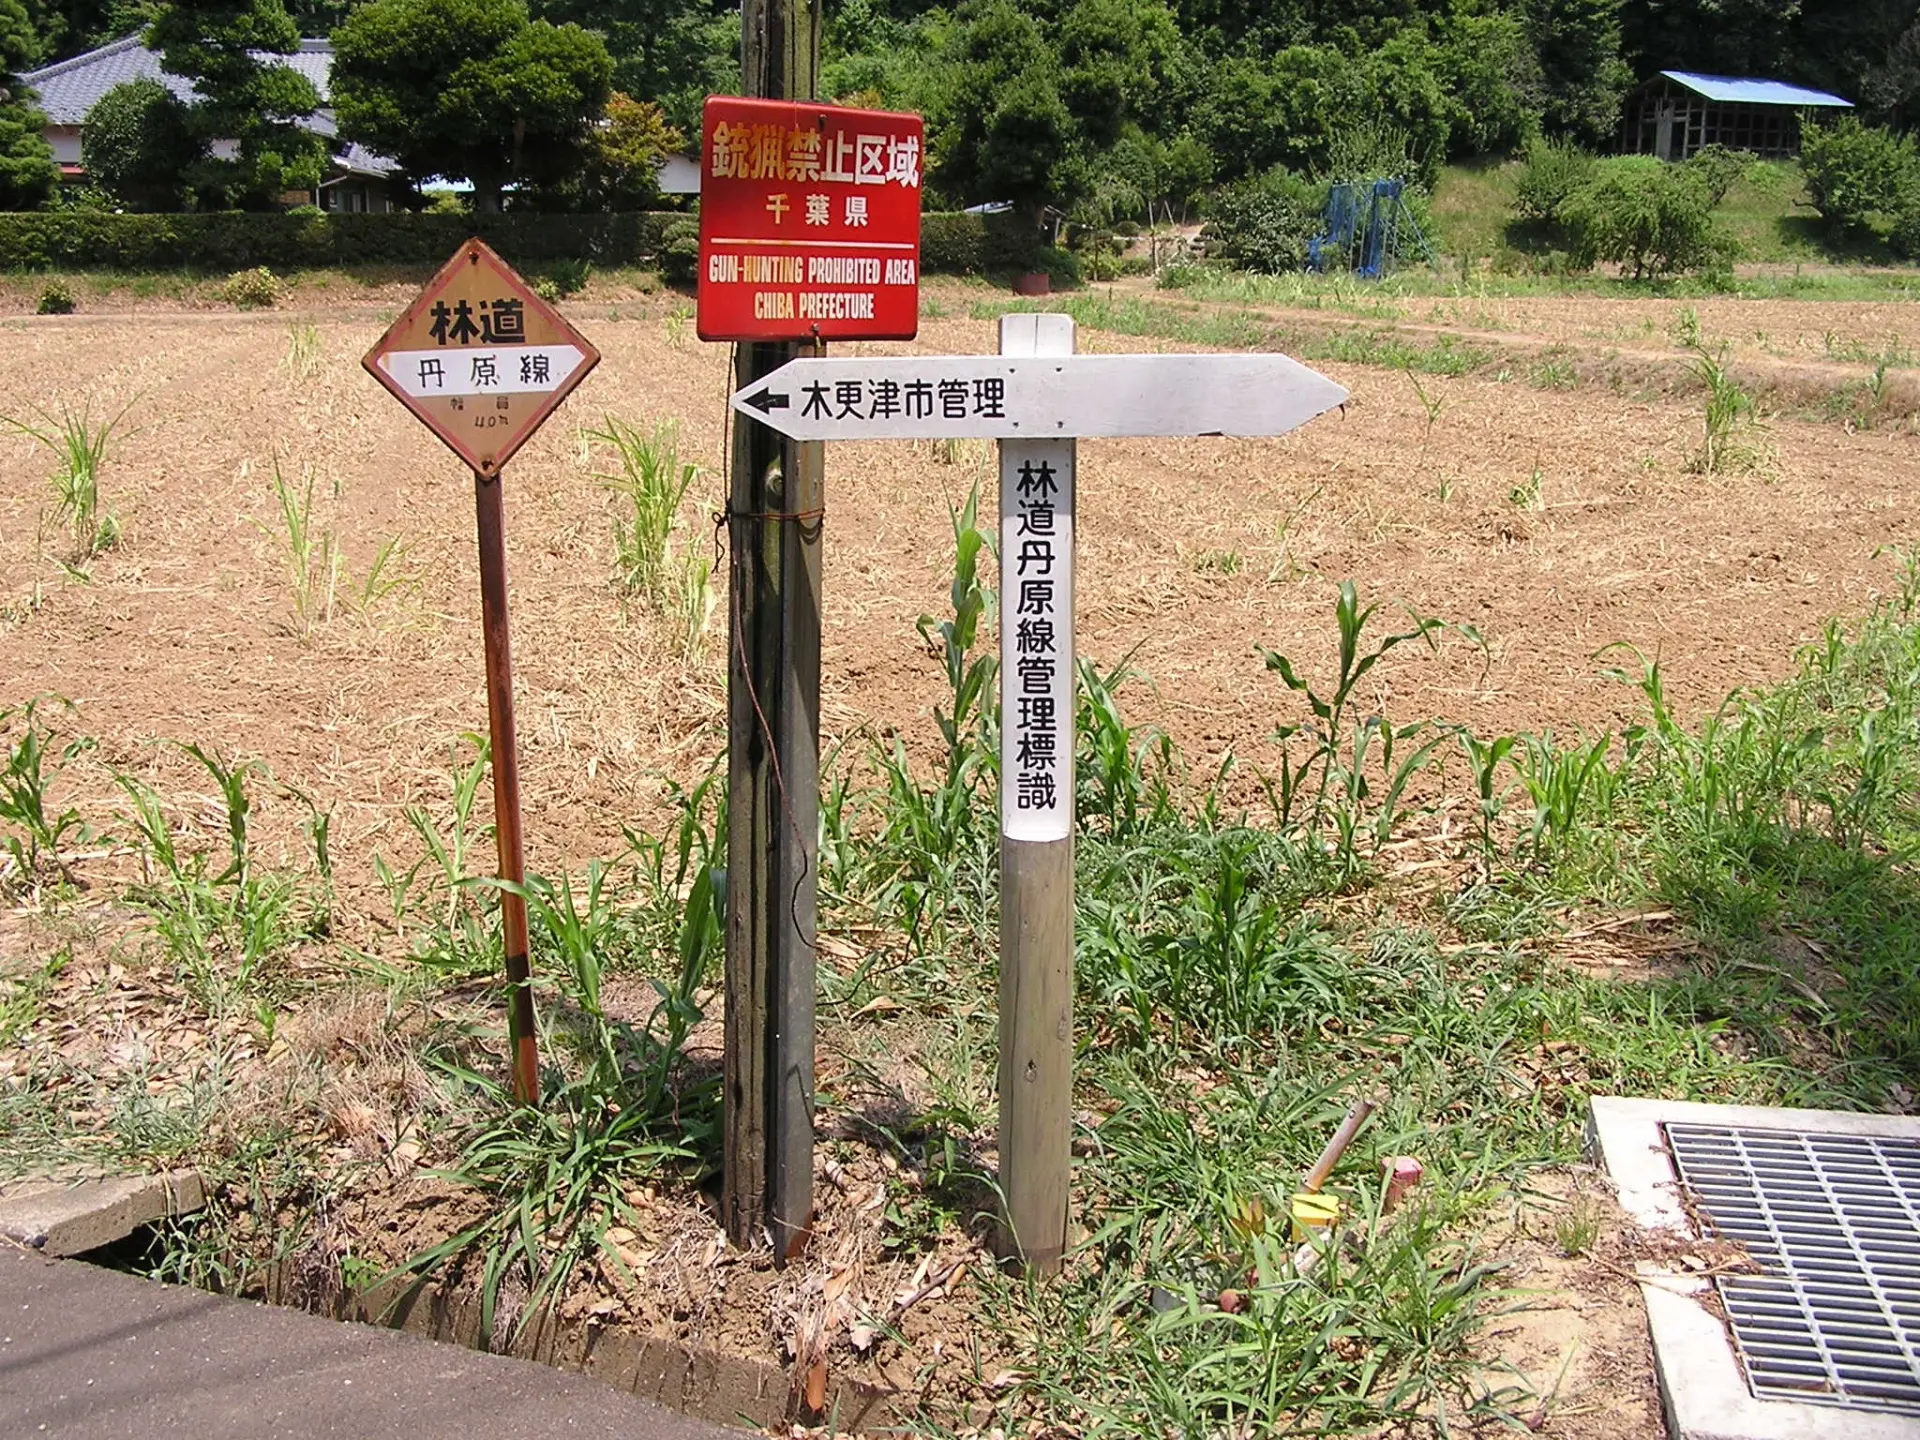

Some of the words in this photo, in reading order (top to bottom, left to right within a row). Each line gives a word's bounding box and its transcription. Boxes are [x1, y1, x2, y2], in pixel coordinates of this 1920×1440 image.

[712, 121, 919, 188] 銃猟禁止区域
[766, 193, 868, 227] 千葉県
[709, 255, 803, 284] GUN-HUNTING
[808, 257, 880, 285] PROHIBITED
[885, 259, 916, 285] AREA
[429, 299, 526, 345] 林道
[755, 292, 794, 320] CHIBA
[799, 293, 874, 320] PREFECTURE
[418, 354, 550, 388] 丹原線
[801, 378, 1005, 420] 木更津市管理
[1016, 460, 1058, 810] 林道丹原線管理標識
